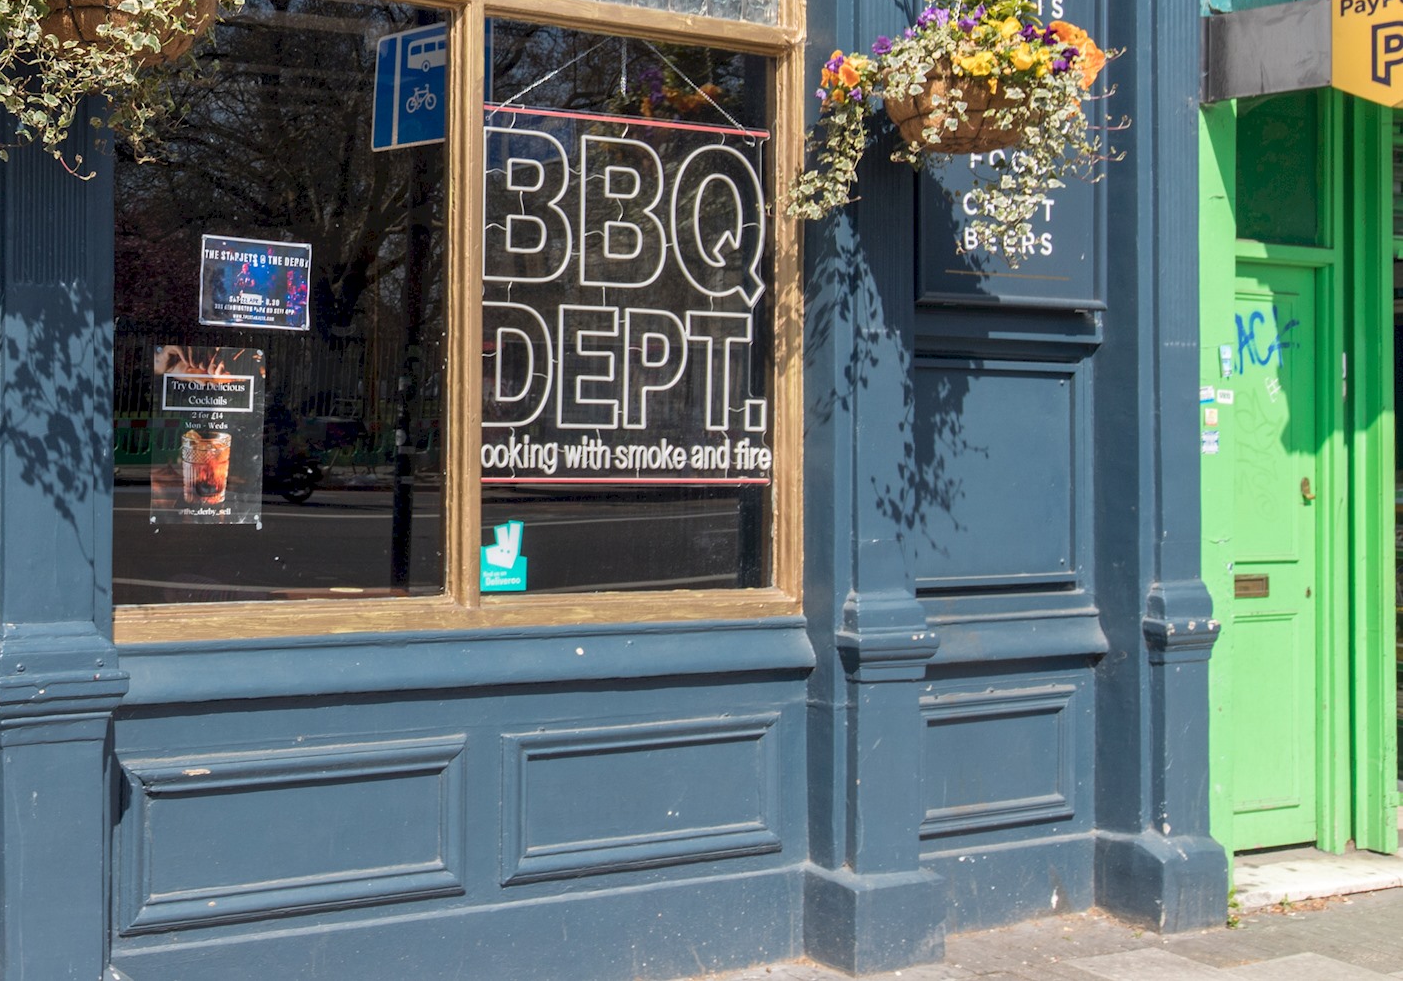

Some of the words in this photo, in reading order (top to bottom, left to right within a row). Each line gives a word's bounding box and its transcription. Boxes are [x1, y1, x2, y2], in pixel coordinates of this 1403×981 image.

[482, 125, 766, 308] BBQ
[205, 249, 219, 259] THE
[268, 256, 282, 266] THE
[481, 301, 767, 432] DEPT.
[171, 381, 186, 392] Try
[207, 381, 245, 392] Delicious
[188, 395, 228, 406] Cocktails
[198, 411, 209, 419] for
[208, 422, 228, 430] Weds
[481, 434, 558, 474] ooking
[564, 435, 611, 470] with
[614, 438, 687, 470] smoke
[690, 438, 730, 470] and
[735, 437, 772, 470] fire
